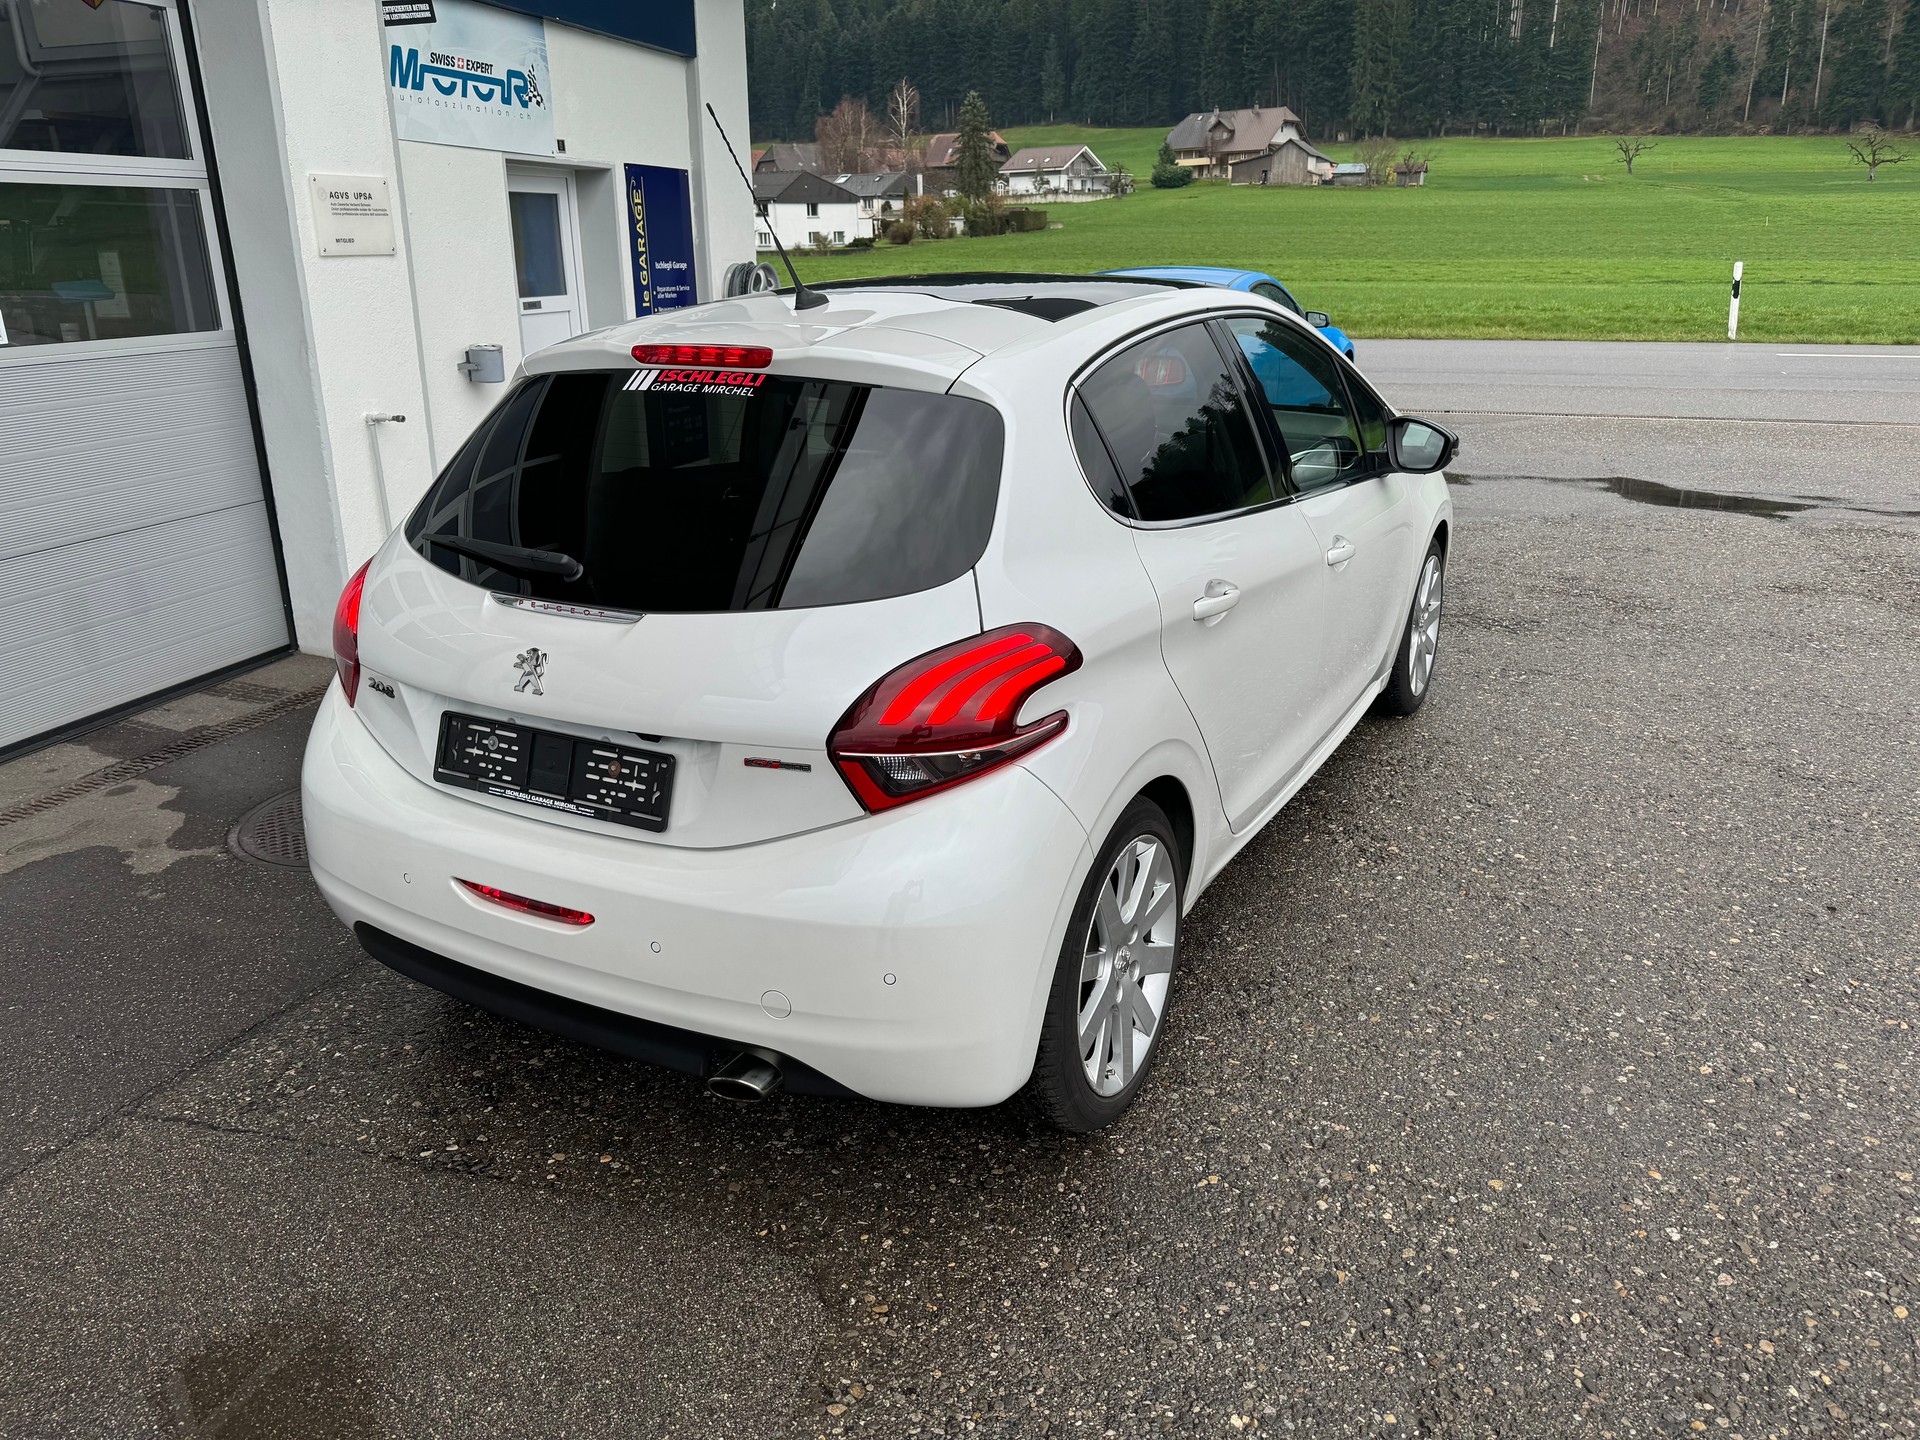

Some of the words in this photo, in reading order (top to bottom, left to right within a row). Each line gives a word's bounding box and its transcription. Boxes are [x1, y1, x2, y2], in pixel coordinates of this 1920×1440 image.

[430, 52, 456, 68] SWISS
[466, 59, 494, 75] EXPERT
[399, 94, 532, 120] utofaszination.ch
[329, 191, 349, 200] AGVS
[353, 192, 373, 200] UPSA
[633, 188, 649, 286] GARAGE
[673, 261, 687, 270] Garage
[642, 290, 650, 307] le
[657, 370, 766, 386] ISCHLEGLI
[651, 382, 700, 393] GARAGE
[701, 385, 755, 397] MIRCHEL
[518, 599, 605, 617] PEUGEOT
[368, 677, 395, 699] 208
[505, 789, 531, 800] ISCHLEGLI
[531, 795, 553, 805] GARAGE
[554, 800, 577, 810] MIRCHEL
